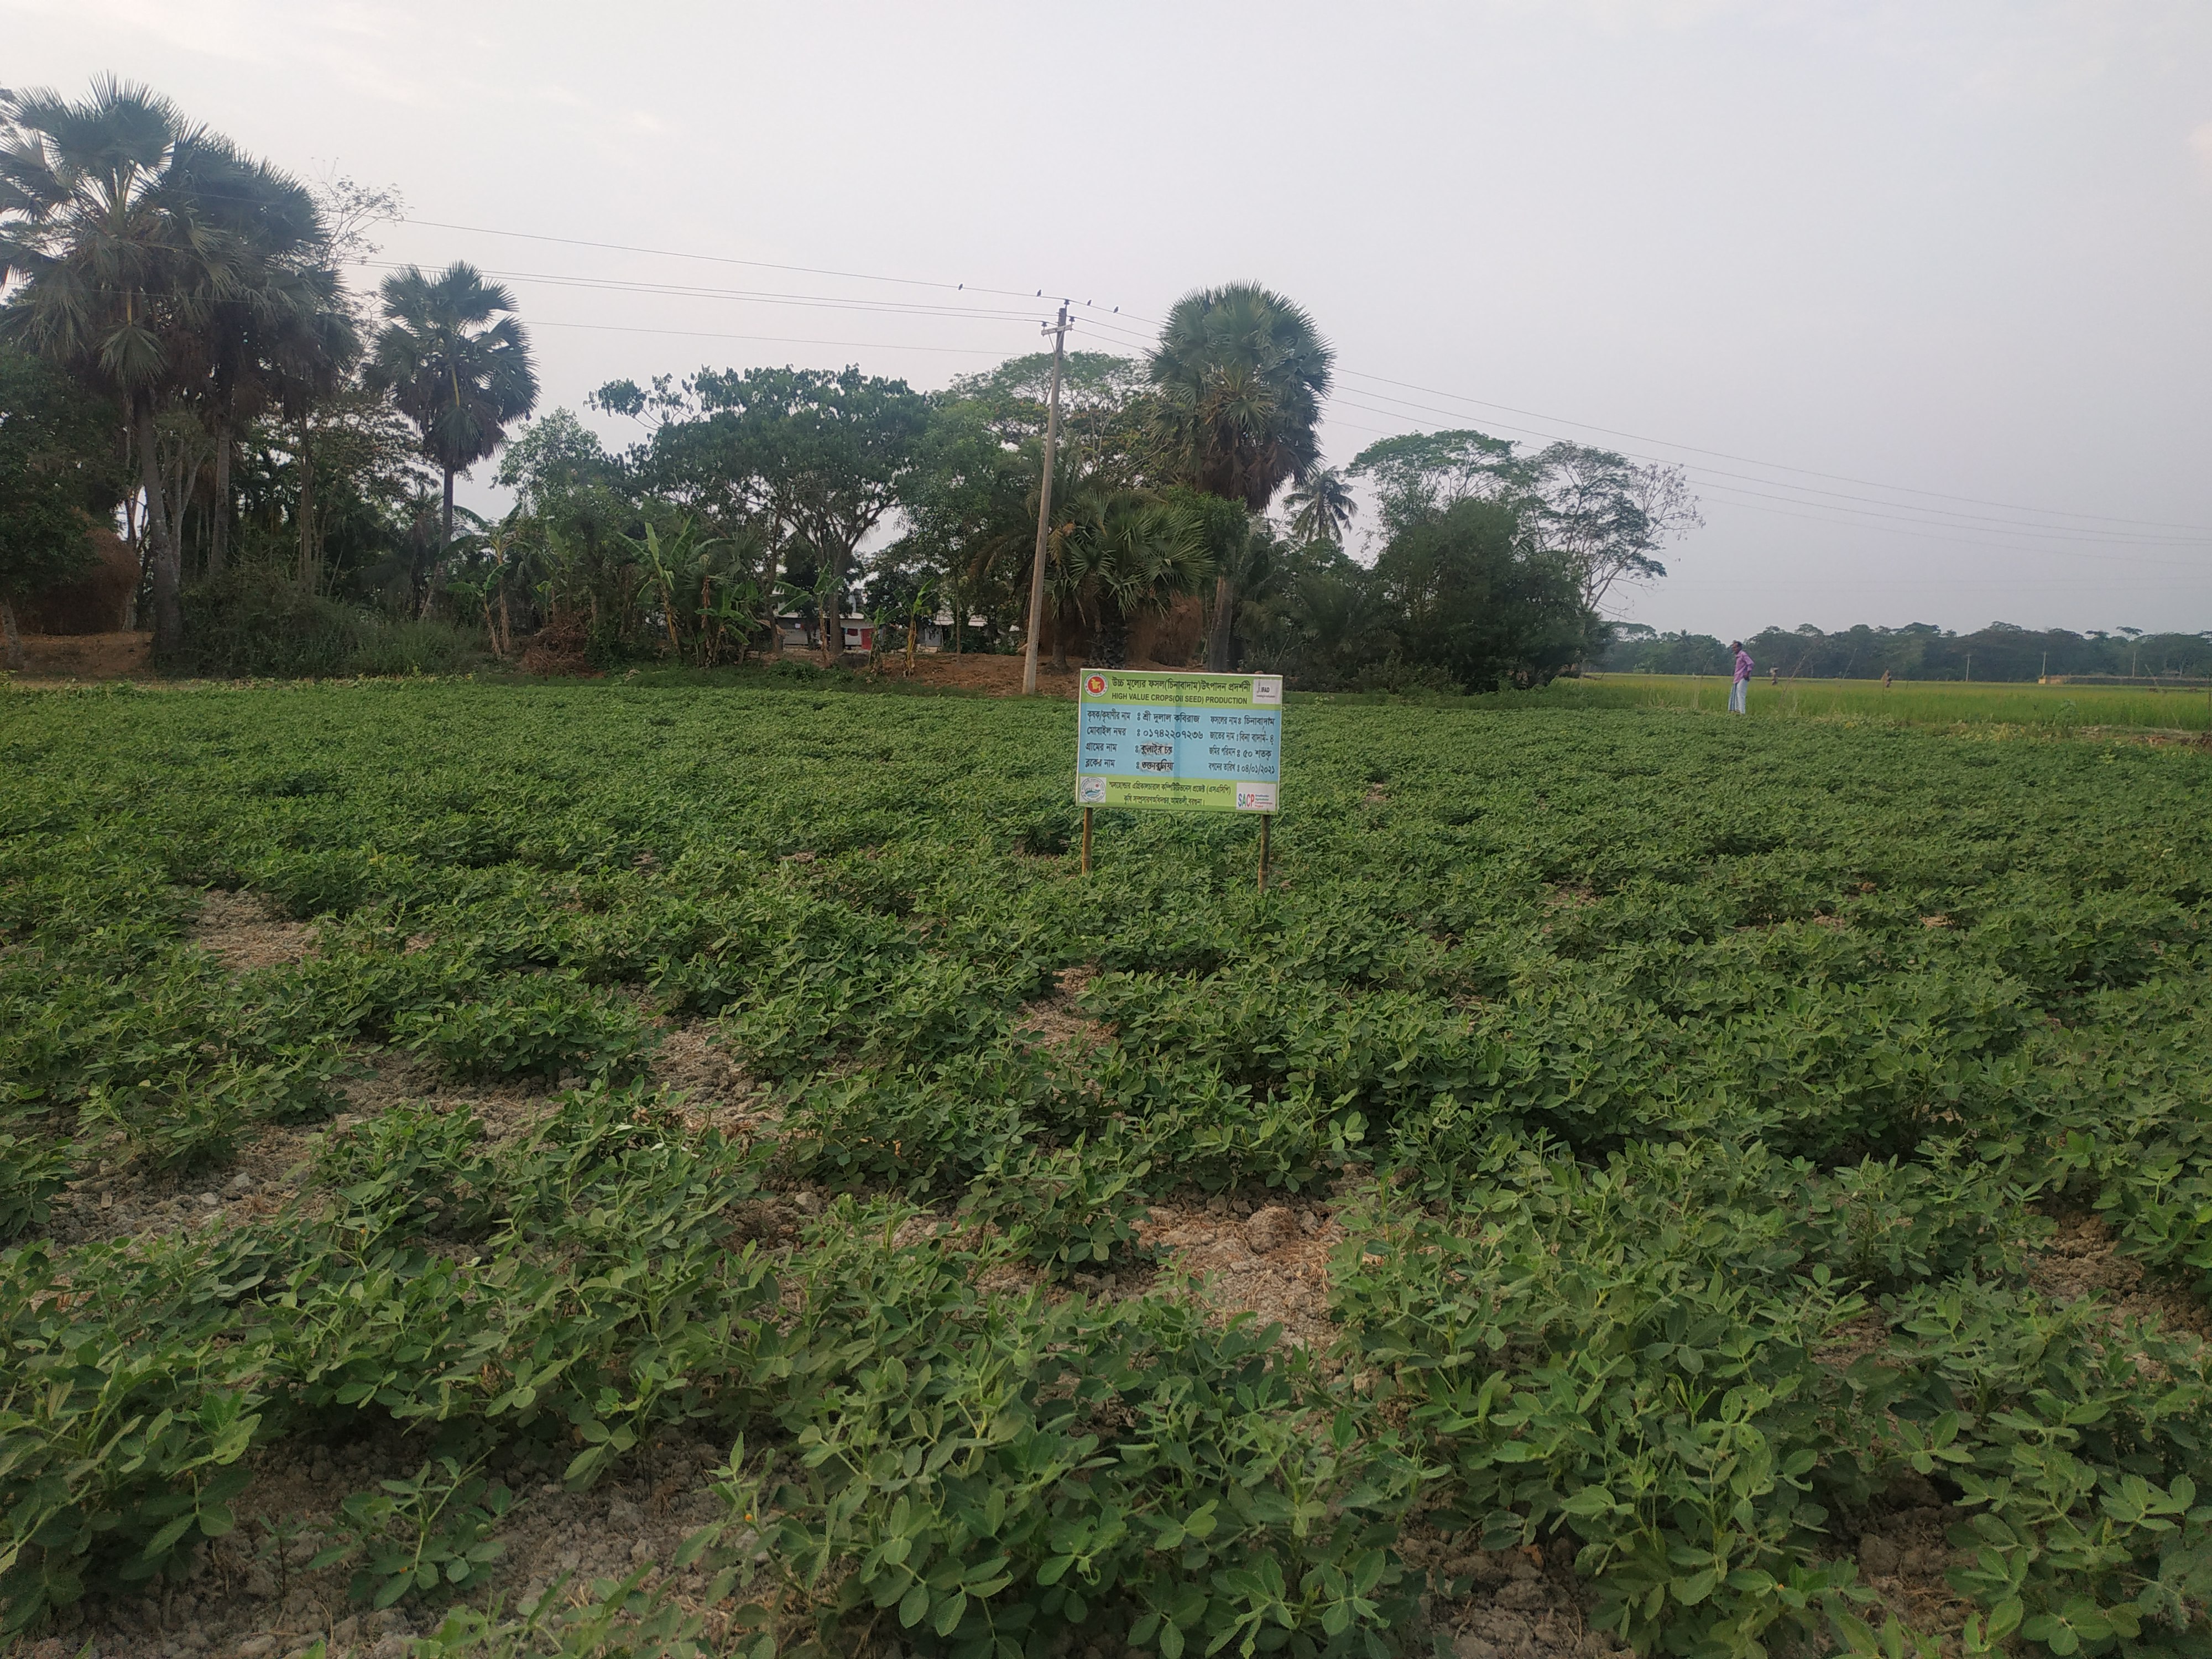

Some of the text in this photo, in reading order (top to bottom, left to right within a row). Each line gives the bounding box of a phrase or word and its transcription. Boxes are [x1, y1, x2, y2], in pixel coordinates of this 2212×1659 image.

[1112, 676, 1125, 687] উচ্চ
[1126, 679, 1146, 691] মূল্যের
[1228, 680, 1251, 692] প্রদর্শনী
[1185, 695, 1204, 704] SEED)
[1121, 712, 1131, 721] নাম
[1142, 710, 1151, 722] শ্রী
[1153, 713, 1172, 723] দুলাল
[1173, 712, 1201, 723] কবিরাজ
[1210, 716, 1228, 725] ফসলের
[1244, 715, 1275, 726] চিনাবাদাম
[1087, 724, 1112, 737] মোবাইল
[1113, 727, 1126, 736] নম্বর
[1143, 728, 1203, 740] ০১৭৪২২০৭২৩৬
[1209, 732, 1225, 740] জাতের
[1226, 732, 1235, 740] নাম
[1239, 731, 1250, 742] বিনা
[1086, 742, 1104, 752] গ্রামের
[1106, 743, 1118, 752] নাম
[1209, 744, 1220, 755] জমির
[1243, 749, 1253, 758] ৫০
[1085, 758, 1102, 768] ব্লকের
[1104, 759, 1115, 768] নাম
[1208, 763, 1222, 771] বপনের
[1223, 761, 1235, 772] তারিখ
[1238, 793, 1255, 807] SACP
